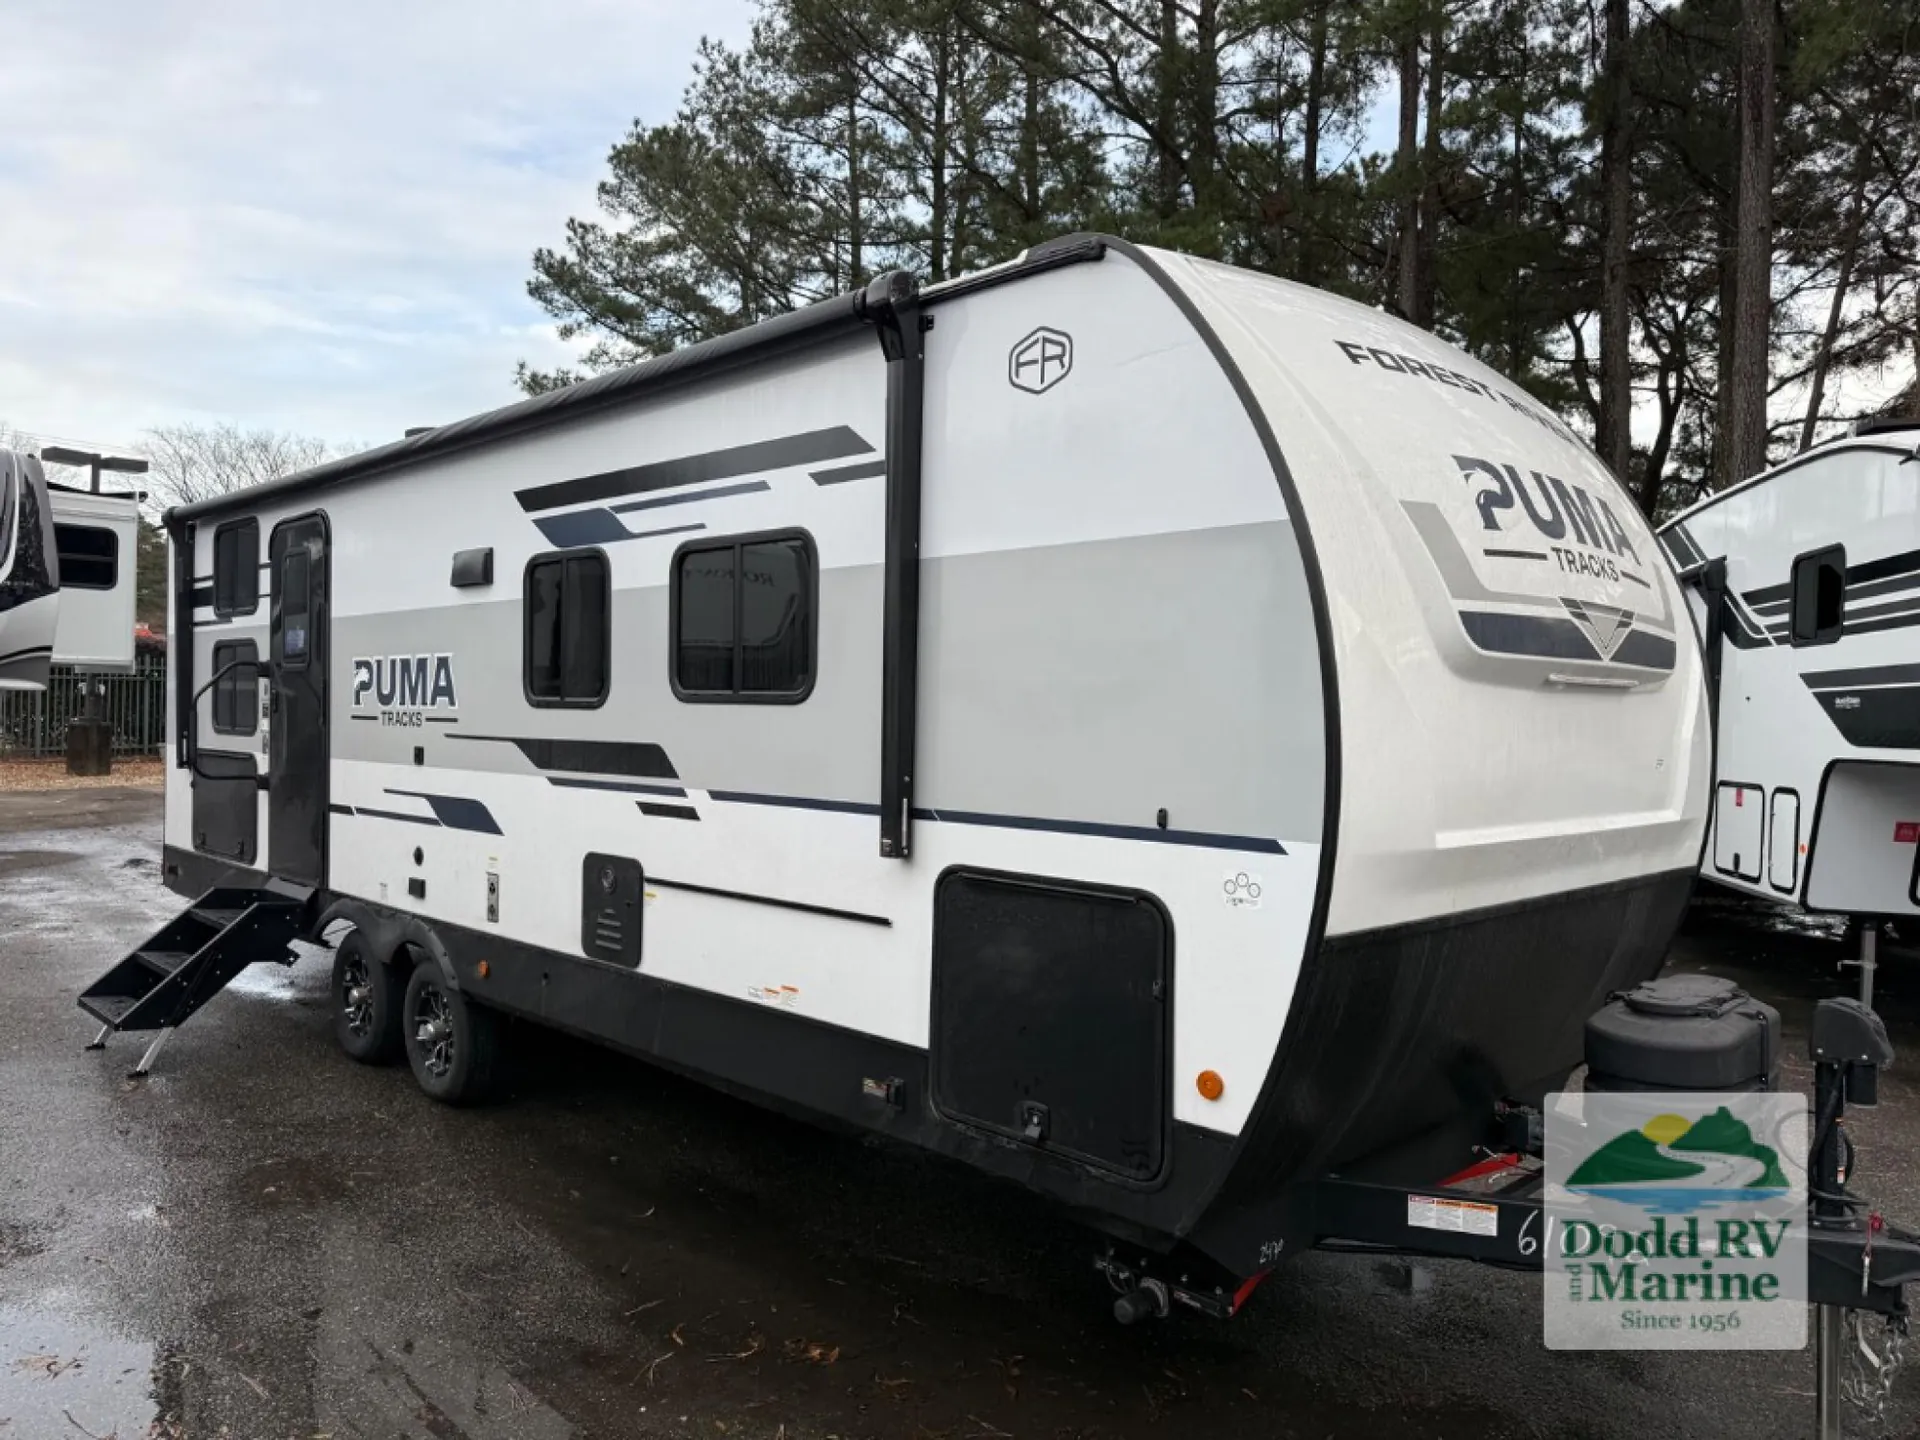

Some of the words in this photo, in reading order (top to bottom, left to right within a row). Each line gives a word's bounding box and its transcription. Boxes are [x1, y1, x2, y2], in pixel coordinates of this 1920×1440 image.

[1333, 339, 1498, 402] FOREST
[1450, 454, 1641, 567] PUMA
[1551, 546, 1620, 583] TRACKS
[352, 653, 458, 709] PUMA
[381, 711, 423, 728] TRACKS
